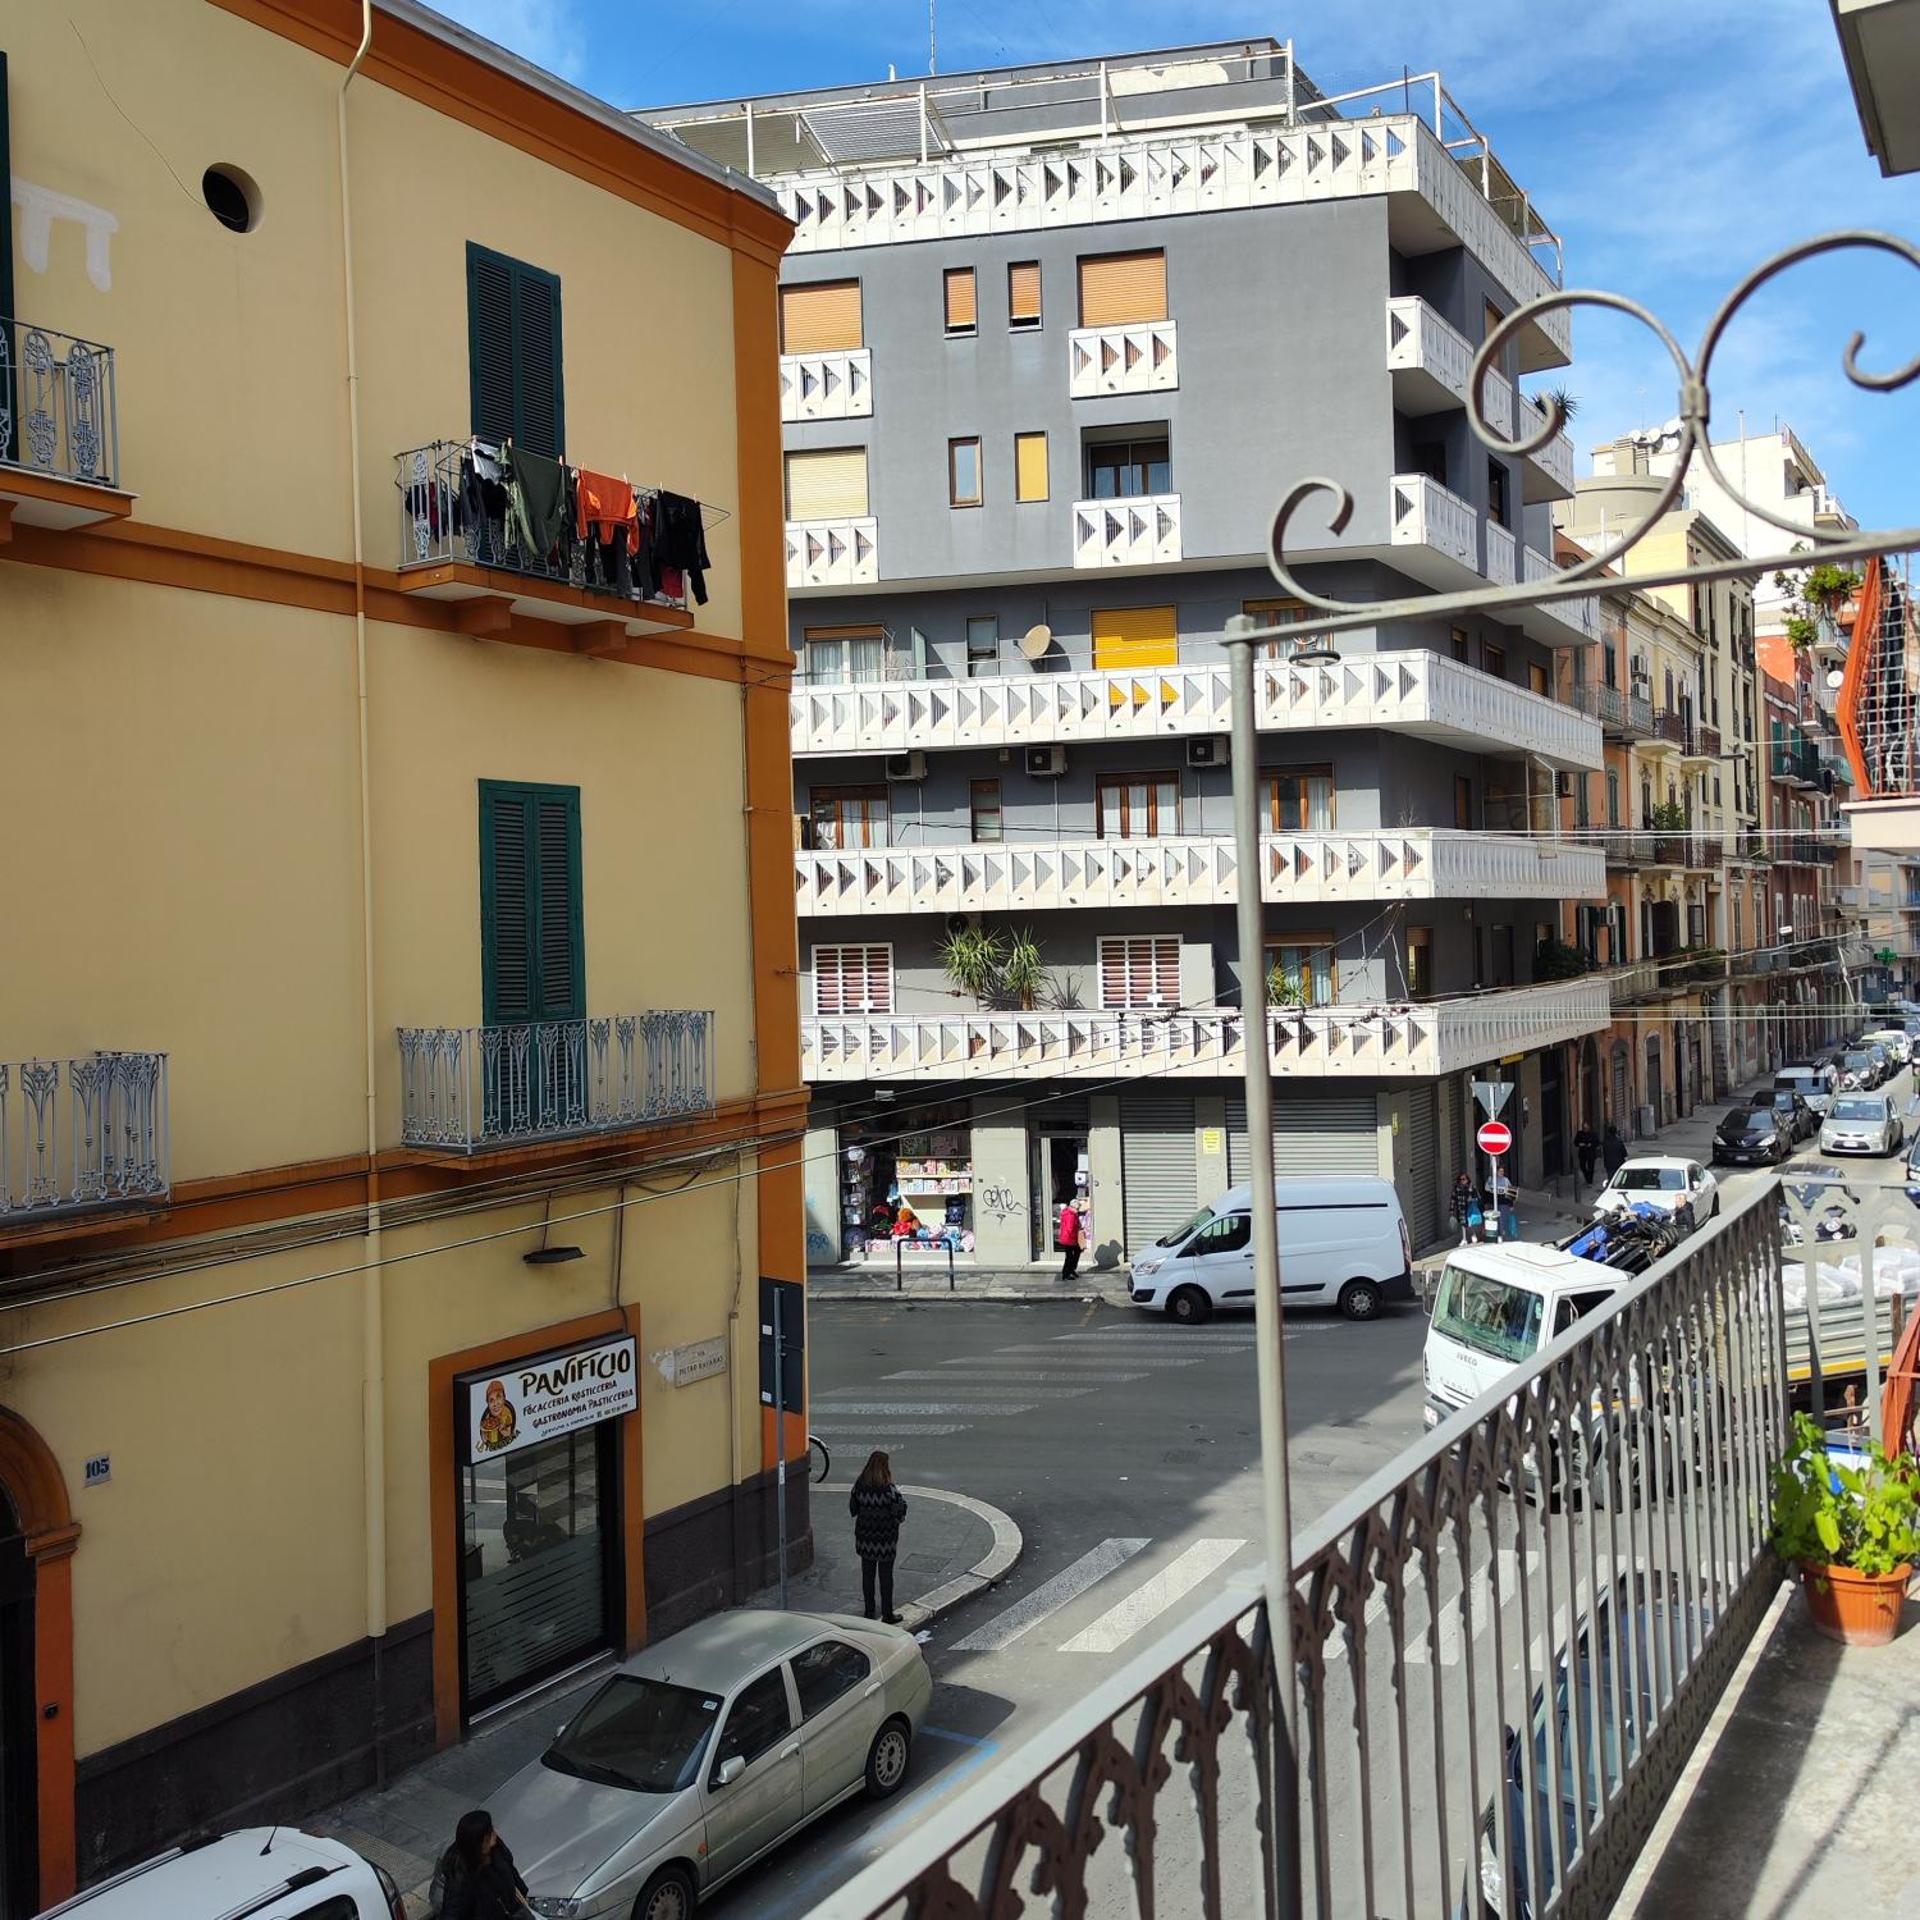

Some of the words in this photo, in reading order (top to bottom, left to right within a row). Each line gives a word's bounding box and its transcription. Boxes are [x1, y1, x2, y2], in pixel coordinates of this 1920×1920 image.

[518, 1348, 631, 1398] PANIFICIO
[1456, 1351, 1479, 1367] IVECO
[522, 1395, 570, 1417] FOCACCERIA
[571, 1379, 618, 1402] ROSTICCERIA
[532, 1404, 588, 1429] GASTRONOMIA
[588, 1388, 635, 1409] PASTICCERIA
[86, 1456, 110, 1479] 105
